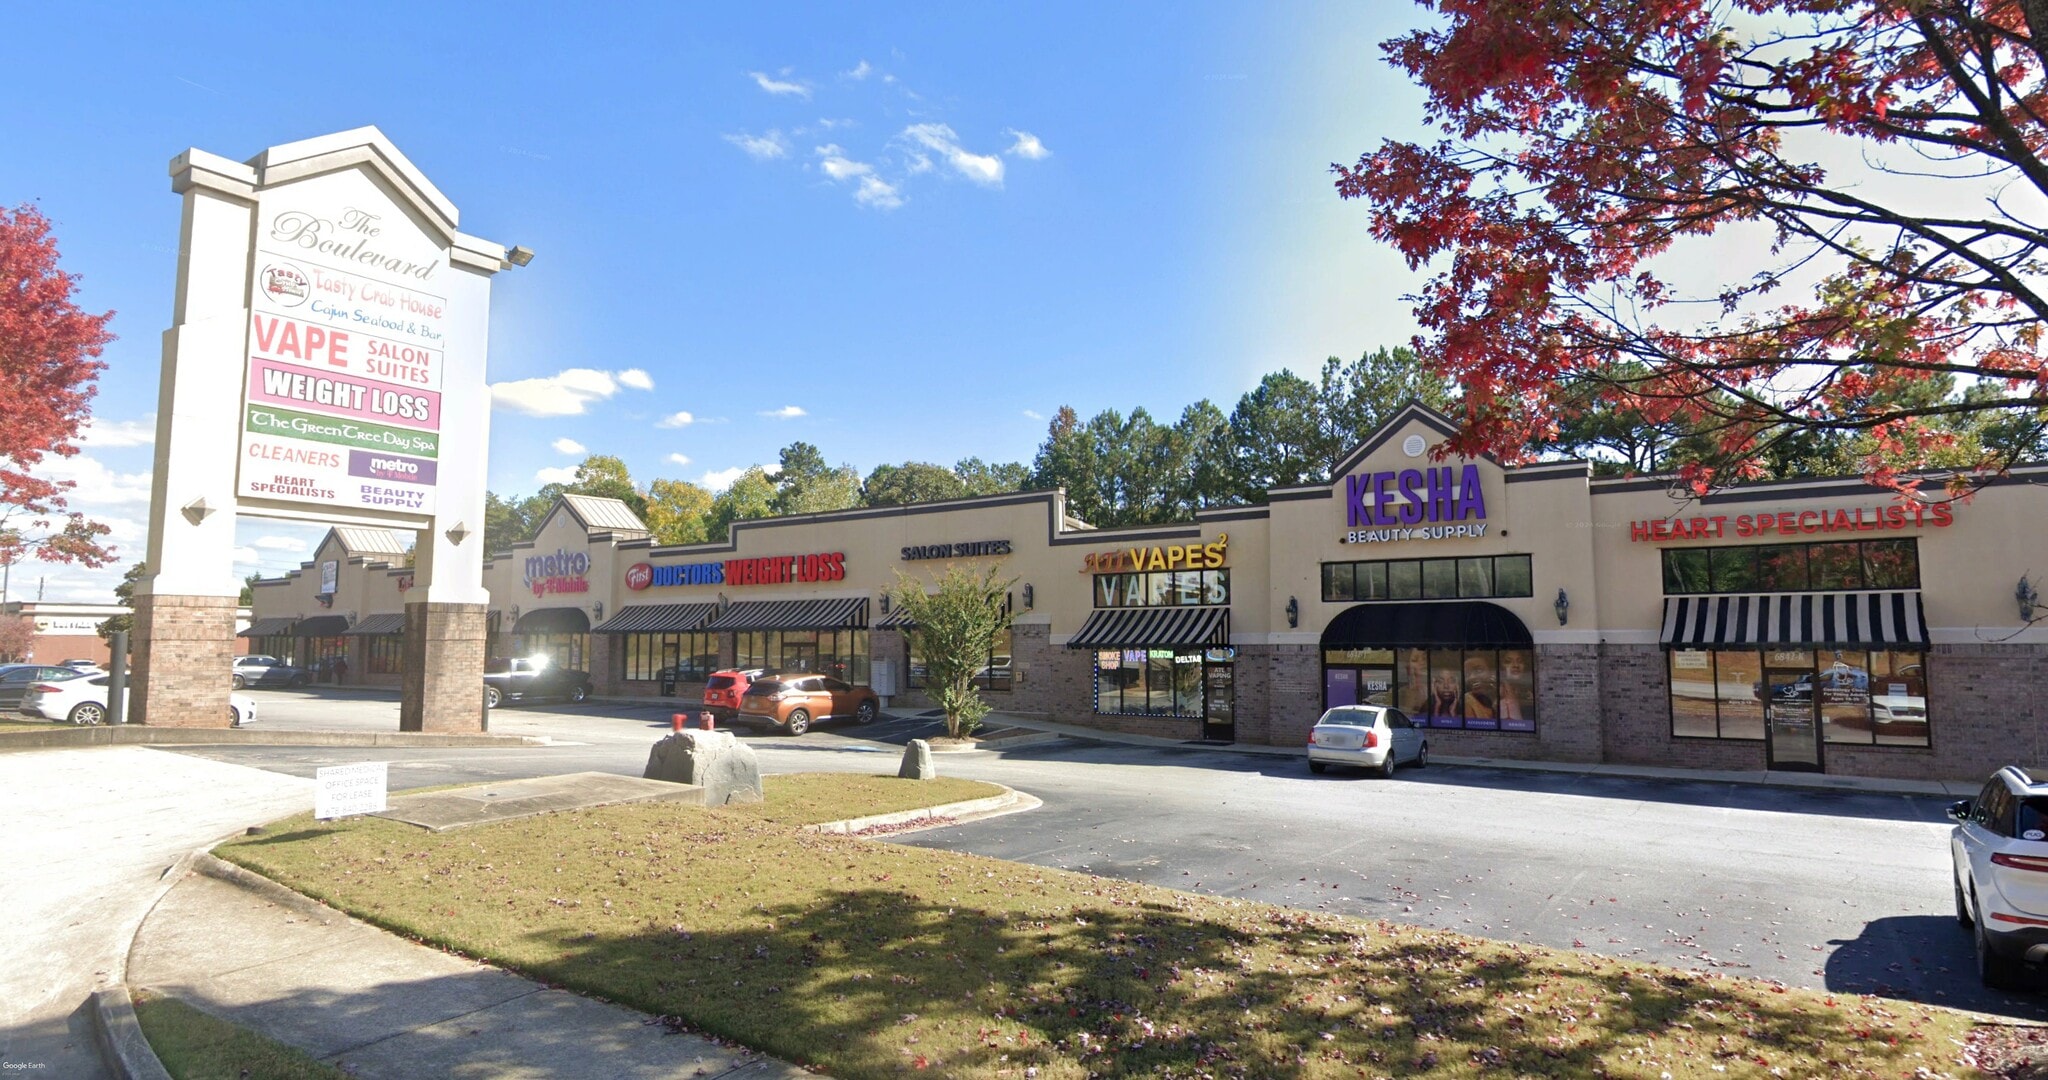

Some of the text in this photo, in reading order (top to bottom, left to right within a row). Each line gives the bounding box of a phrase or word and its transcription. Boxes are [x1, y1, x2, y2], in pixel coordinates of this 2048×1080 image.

[338, 206, 382, 238] The
[270, 210, 439, 281] Boulevard
[312, 268, 355, 302] Tasty
[360, 286, 395, 307] Crab
[401, 296, 442, 320] House
[311, 299, 442, 341] Cajun Seafood & Bar
[254, 314, 349, 368] VAPE
[367, 340, 430, 367] SALON
[366, 358, 430, 384] SUITES
[262, 367, 430, 422] WEIGHT LOSS
[250, 410, 290, 429] The
[382, 431, 411, 450] Day
[412, 437, 436, 452] Spa
[248, 443, 341, 468] CLEANERS
[369, 457, 419, 474] metro
[250, 482, 335, 499] SPECIALISTS
[274, 475, 316, 488] HEART
[360, 484, 425, 500] BEAUTY
[361, 494, 423, 509] SUPPLY
[1346, 464, 1487, 528] KESHA
[1630, 501, 1954, 543] HEART SPECIALISTS
[1348, 523, 1488, 545] BEAUTY SUPPLY
[901, 540, 1012, 561] SALON SUITES
[523, 548, 590, 588] metro
[628, 552, 846, 588] First DOCTORS WEIGHT LOSS
[1099, 651, 1120, 661] SMOKE
[1101, 660, 1119, 670] SHOP
[1123, 650, 1147, 663] VAPE
[1149, 650, 1174, 659] KRATOM
[1367, 681, 1388, 692] KESHA
[319, 768, 350, 778] SHARED
[325, 777, 379, 790] OFFICE SPACE
[331, 789, 373, 801] FOR LEASE
